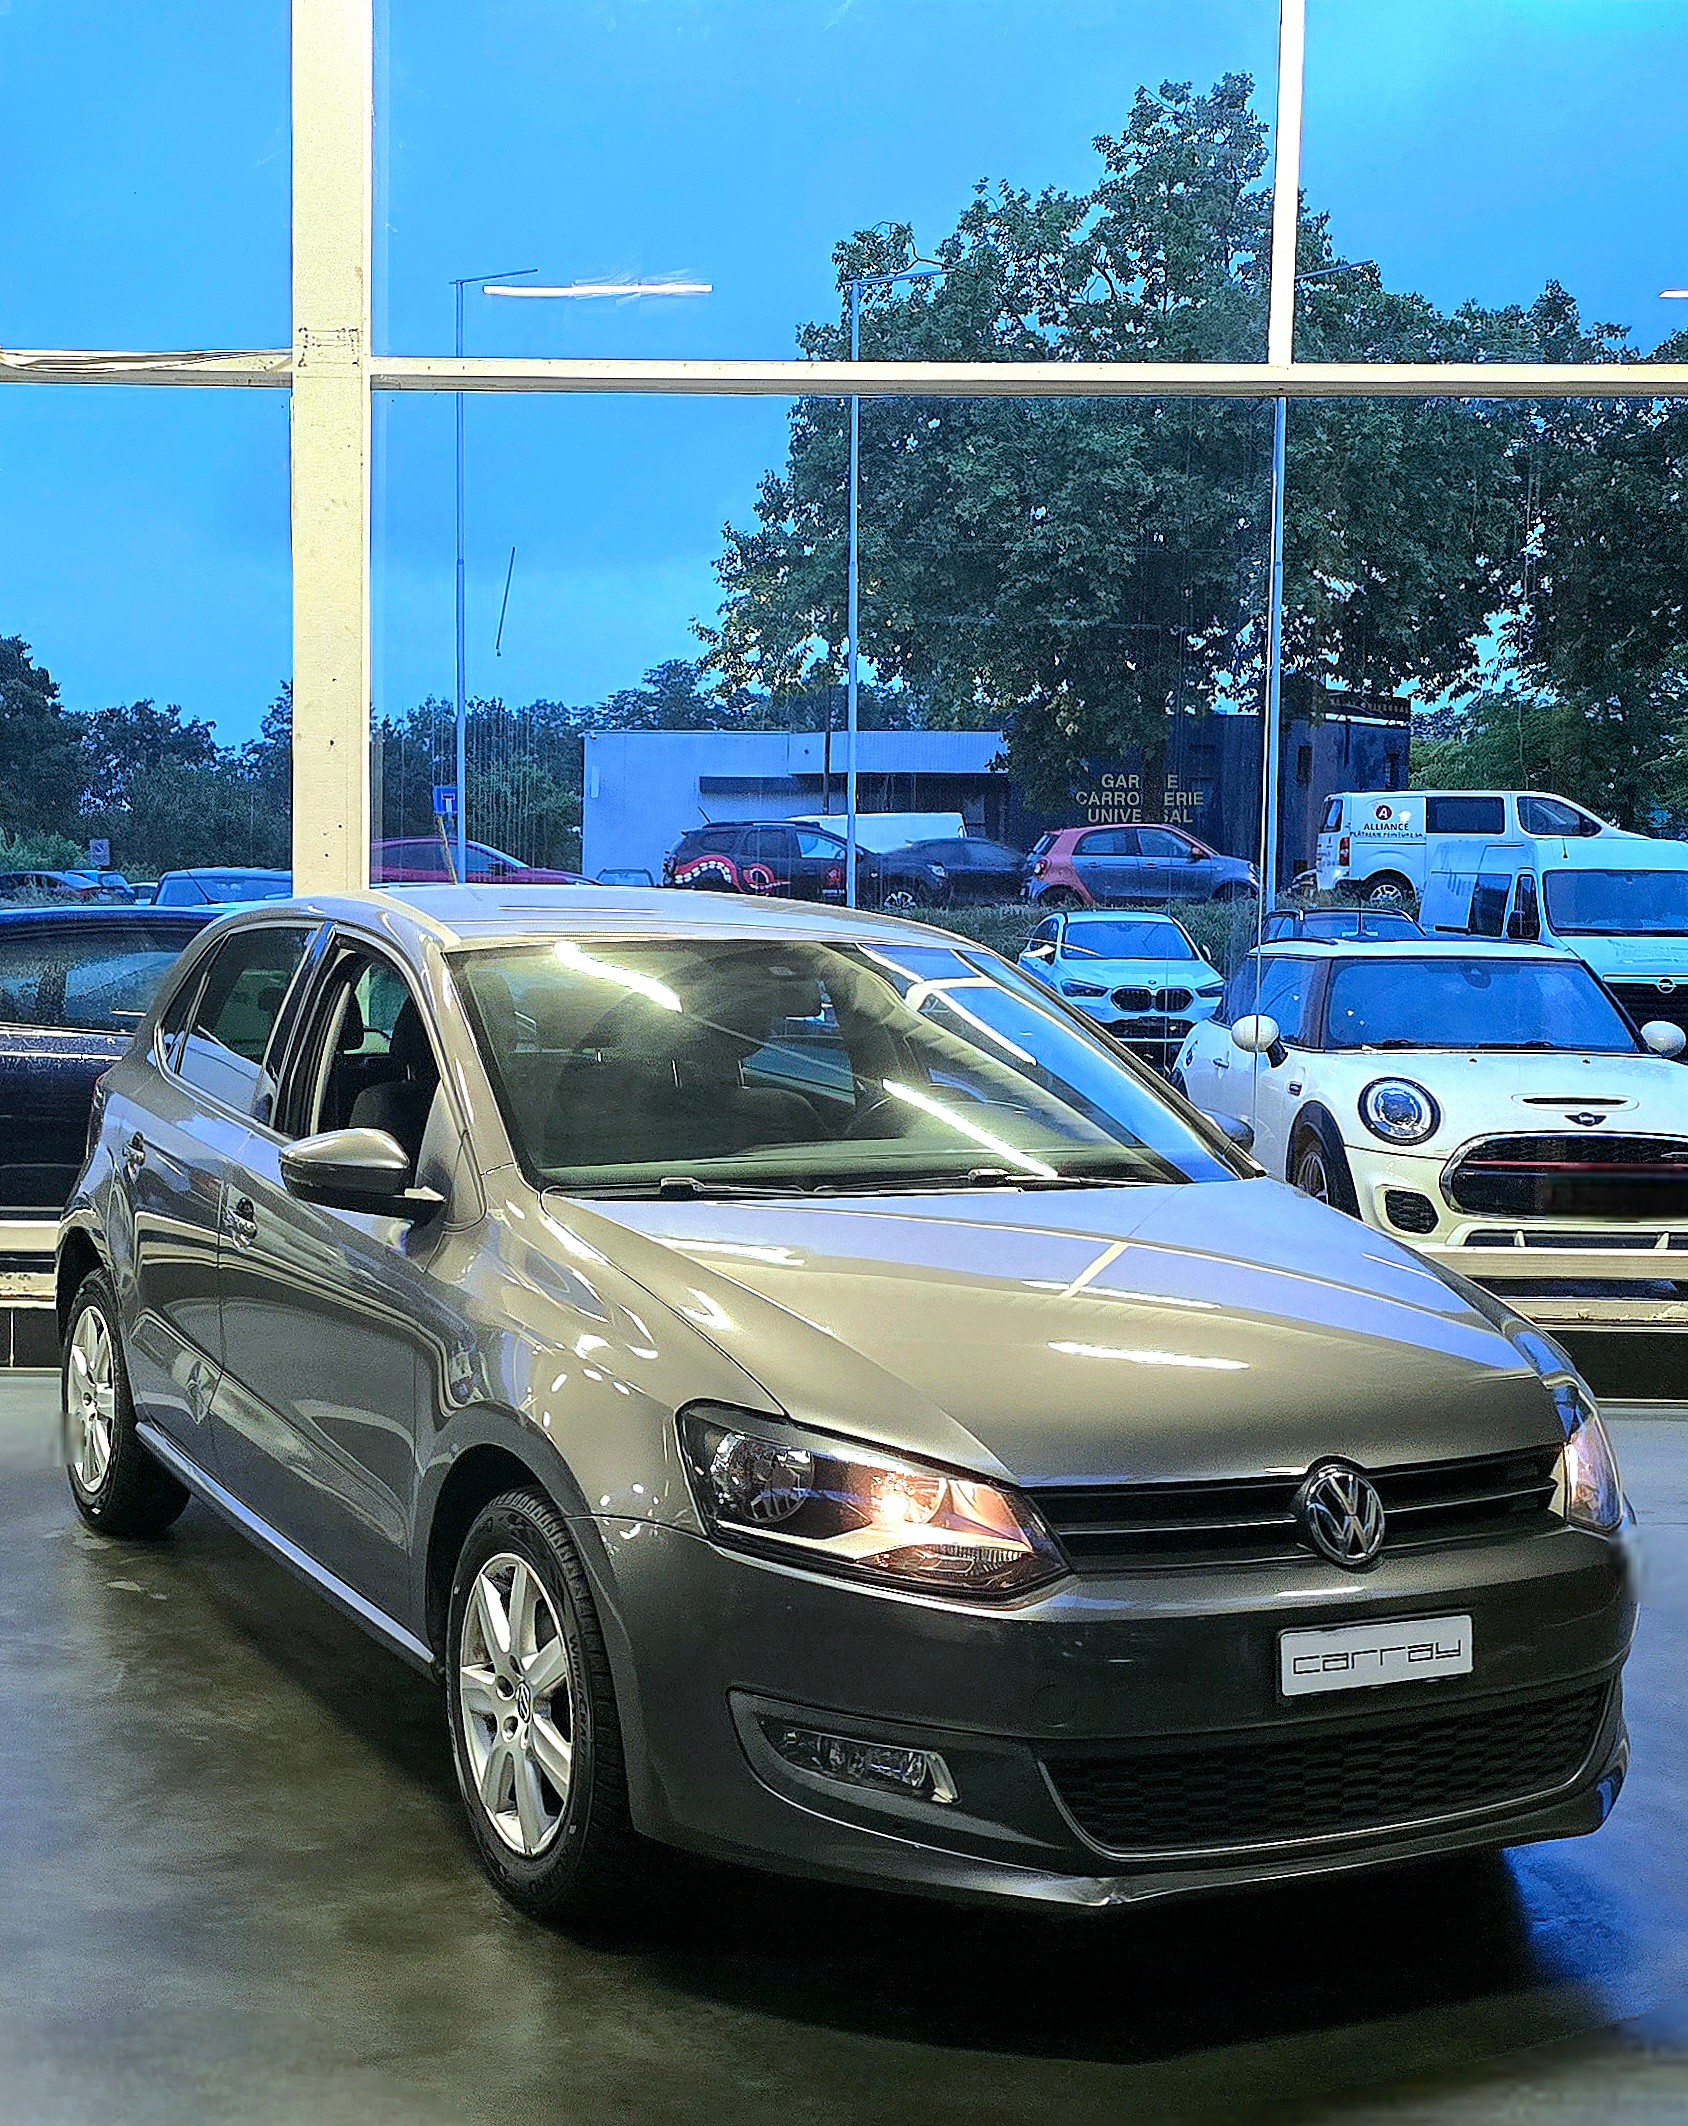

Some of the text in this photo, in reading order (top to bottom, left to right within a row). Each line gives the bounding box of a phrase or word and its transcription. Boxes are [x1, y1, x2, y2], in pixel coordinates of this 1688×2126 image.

[1101, 773, 1179, 789] GARE
[1075, 791, 1204, 806] CARROERIE
[1087, 808, 1194, 823] UNIVEAL
[1363, 823, 1410, 831] ALLIANCE
[1293, 1639, 1462, 1675] carray
